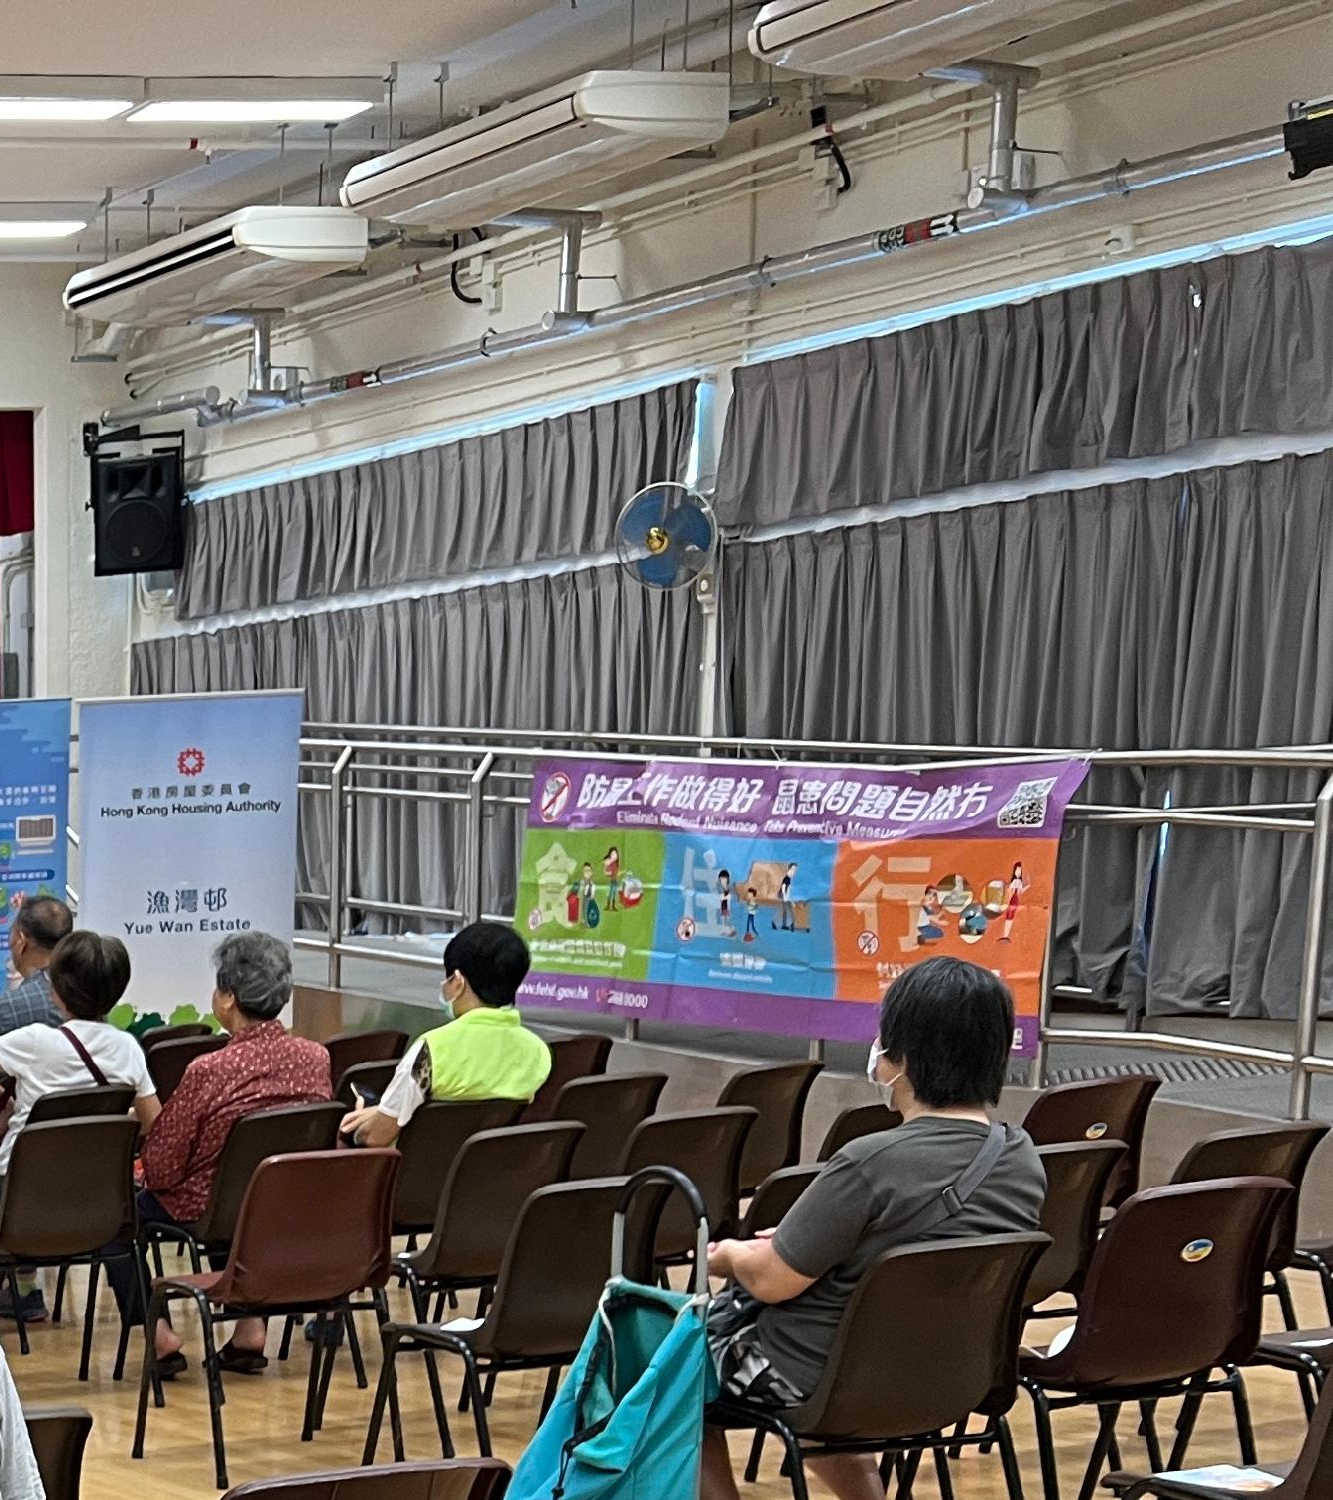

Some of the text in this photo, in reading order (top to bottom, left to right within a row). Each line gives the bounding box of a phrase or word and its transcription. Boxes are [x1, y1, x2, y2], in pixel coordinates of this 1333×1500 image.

[131, 782, 252, 801] 香港房屋委員會
[100, 799, 282, 819] Hong Kong Housing Authority
[146, 886, 228, 915] 漁灣邨
[124, 917, 252, 935] Yue Wan Estate
